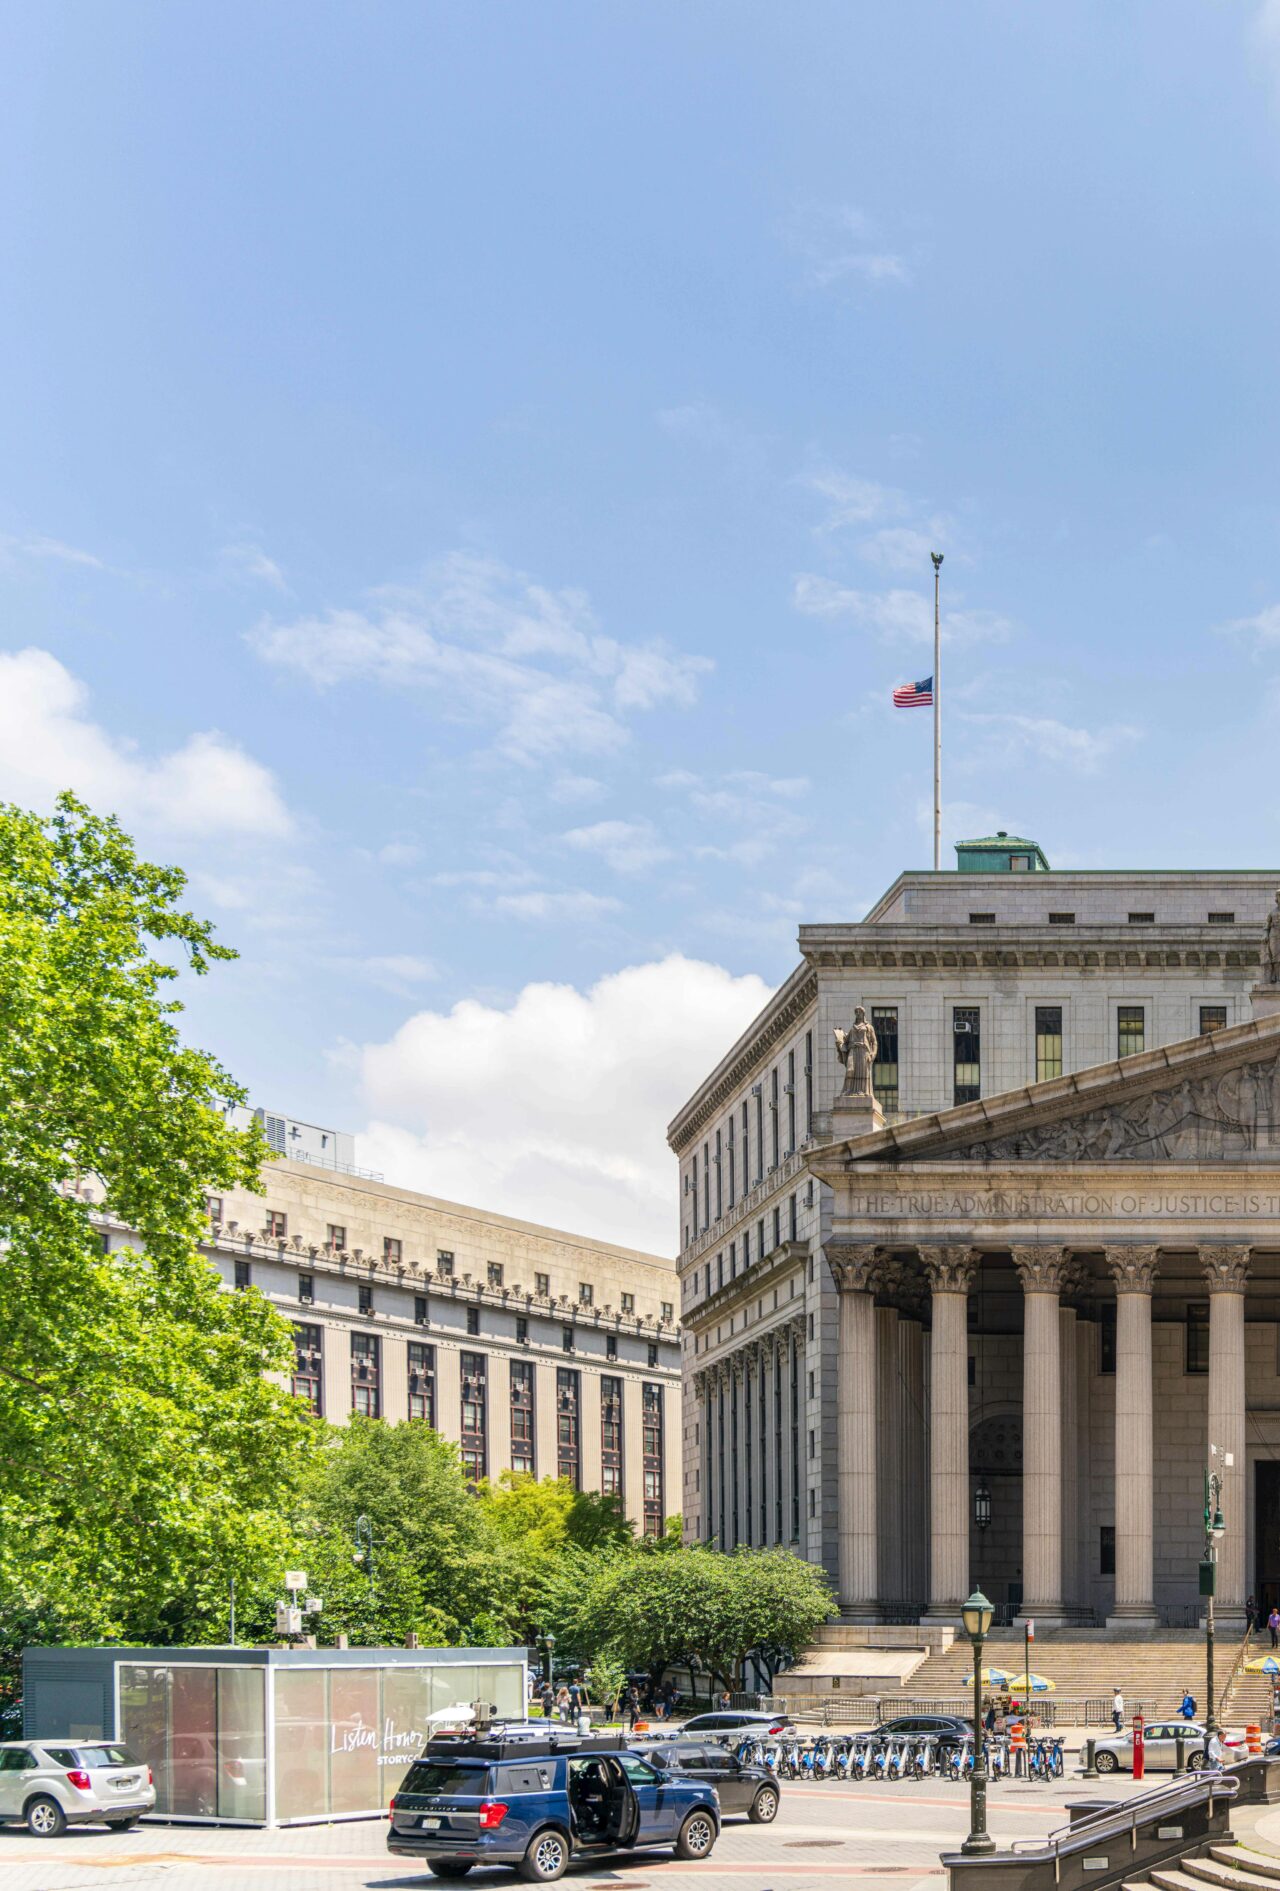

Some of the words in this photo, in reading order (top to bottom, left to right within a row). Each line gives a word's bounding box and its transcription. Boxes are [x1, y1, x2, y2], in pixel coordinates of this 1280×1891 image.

[854, 1195, 890, 1213] THE
[898, 1195, 943, 1213] TRUE
[950, 1195, 1113, 1213] ADMINISTRATION
[1120, 1195, 1146, 1213] OF
[1151, 1195, 1234, 1213] JUSTICE
[1242, 1195, 1260, 1213] IS
